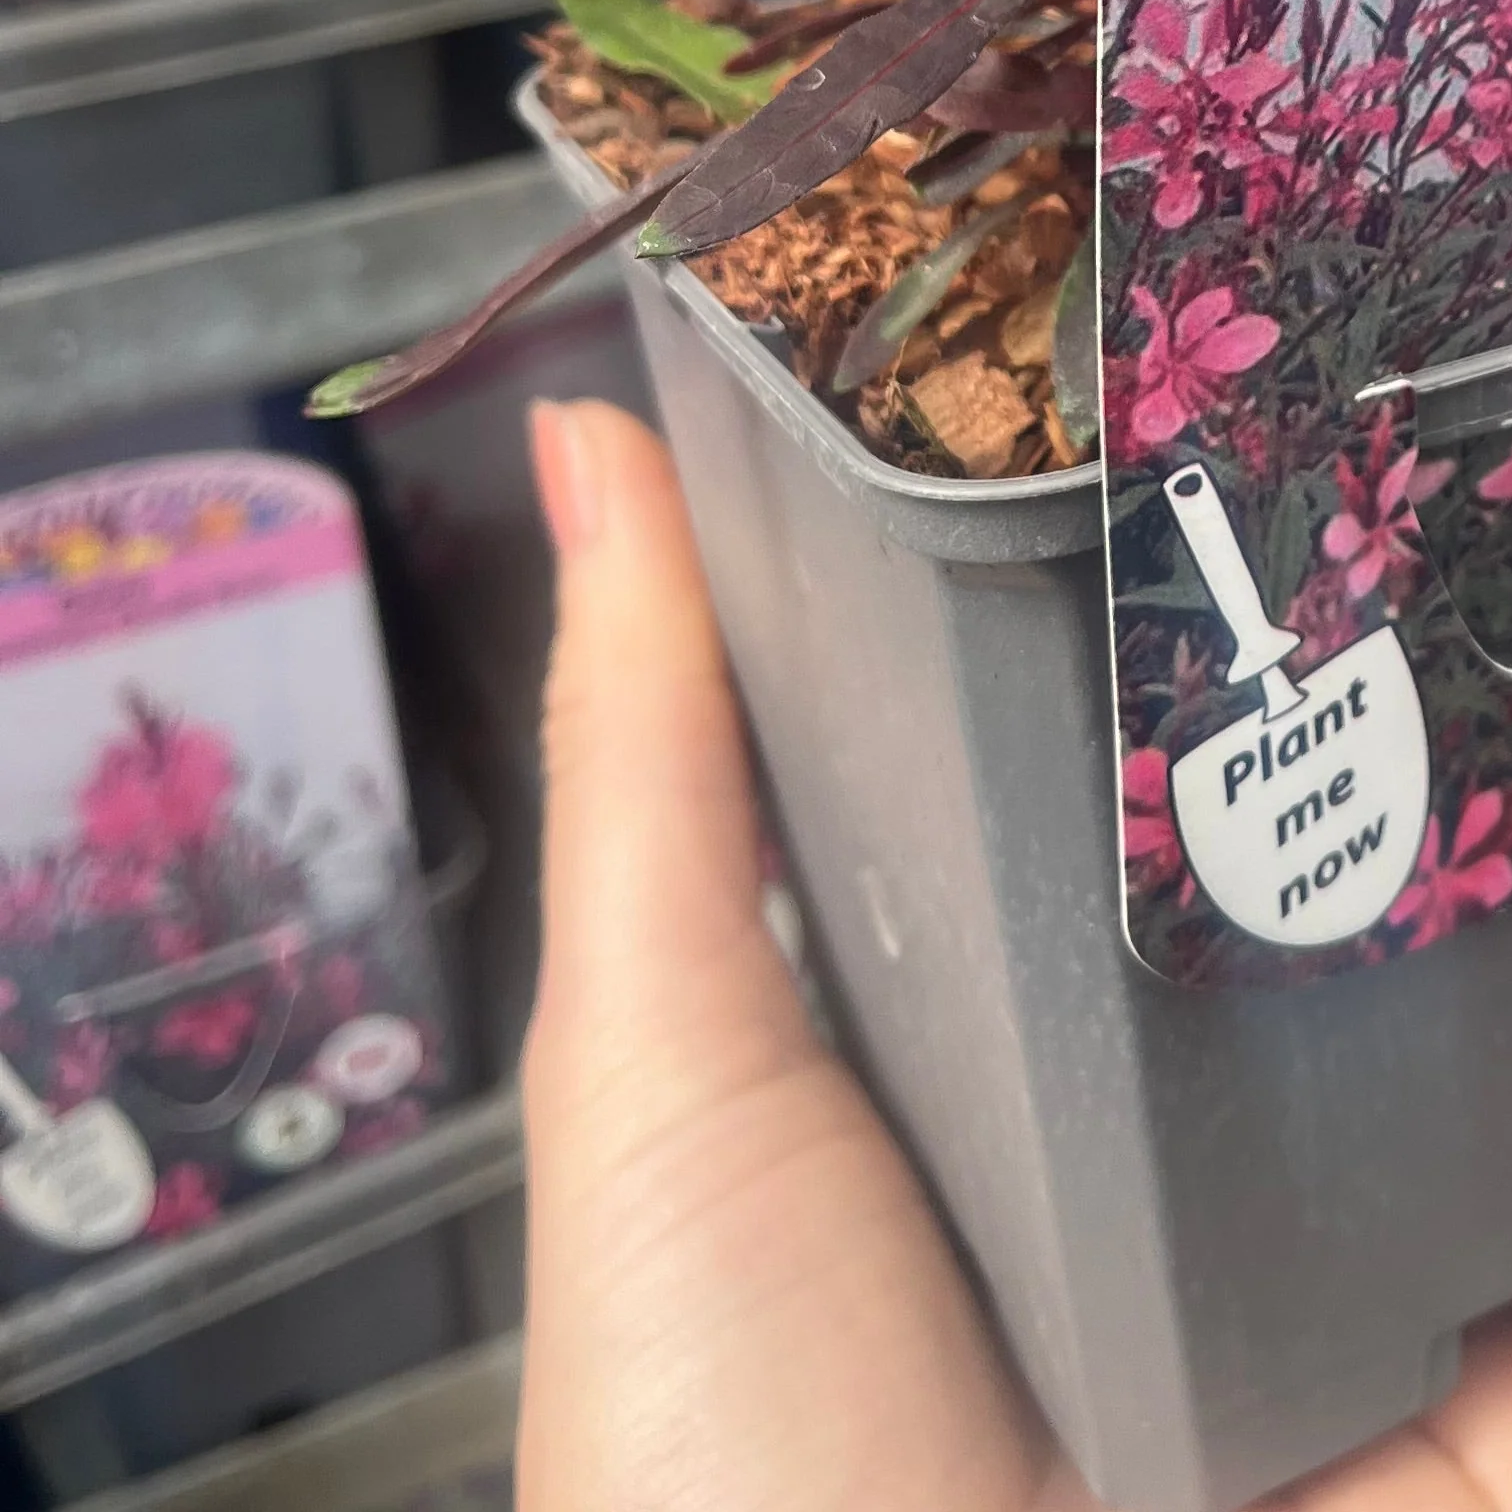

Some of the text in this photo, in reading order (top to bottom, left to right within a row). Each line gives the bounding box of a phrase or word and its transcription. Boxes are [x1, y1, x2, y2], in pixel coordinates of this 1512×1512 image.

[1222, 678, 1369, 806] Plant
[1275, 767, 1357, 847] me
[1280, 812, 1389, 919] now
